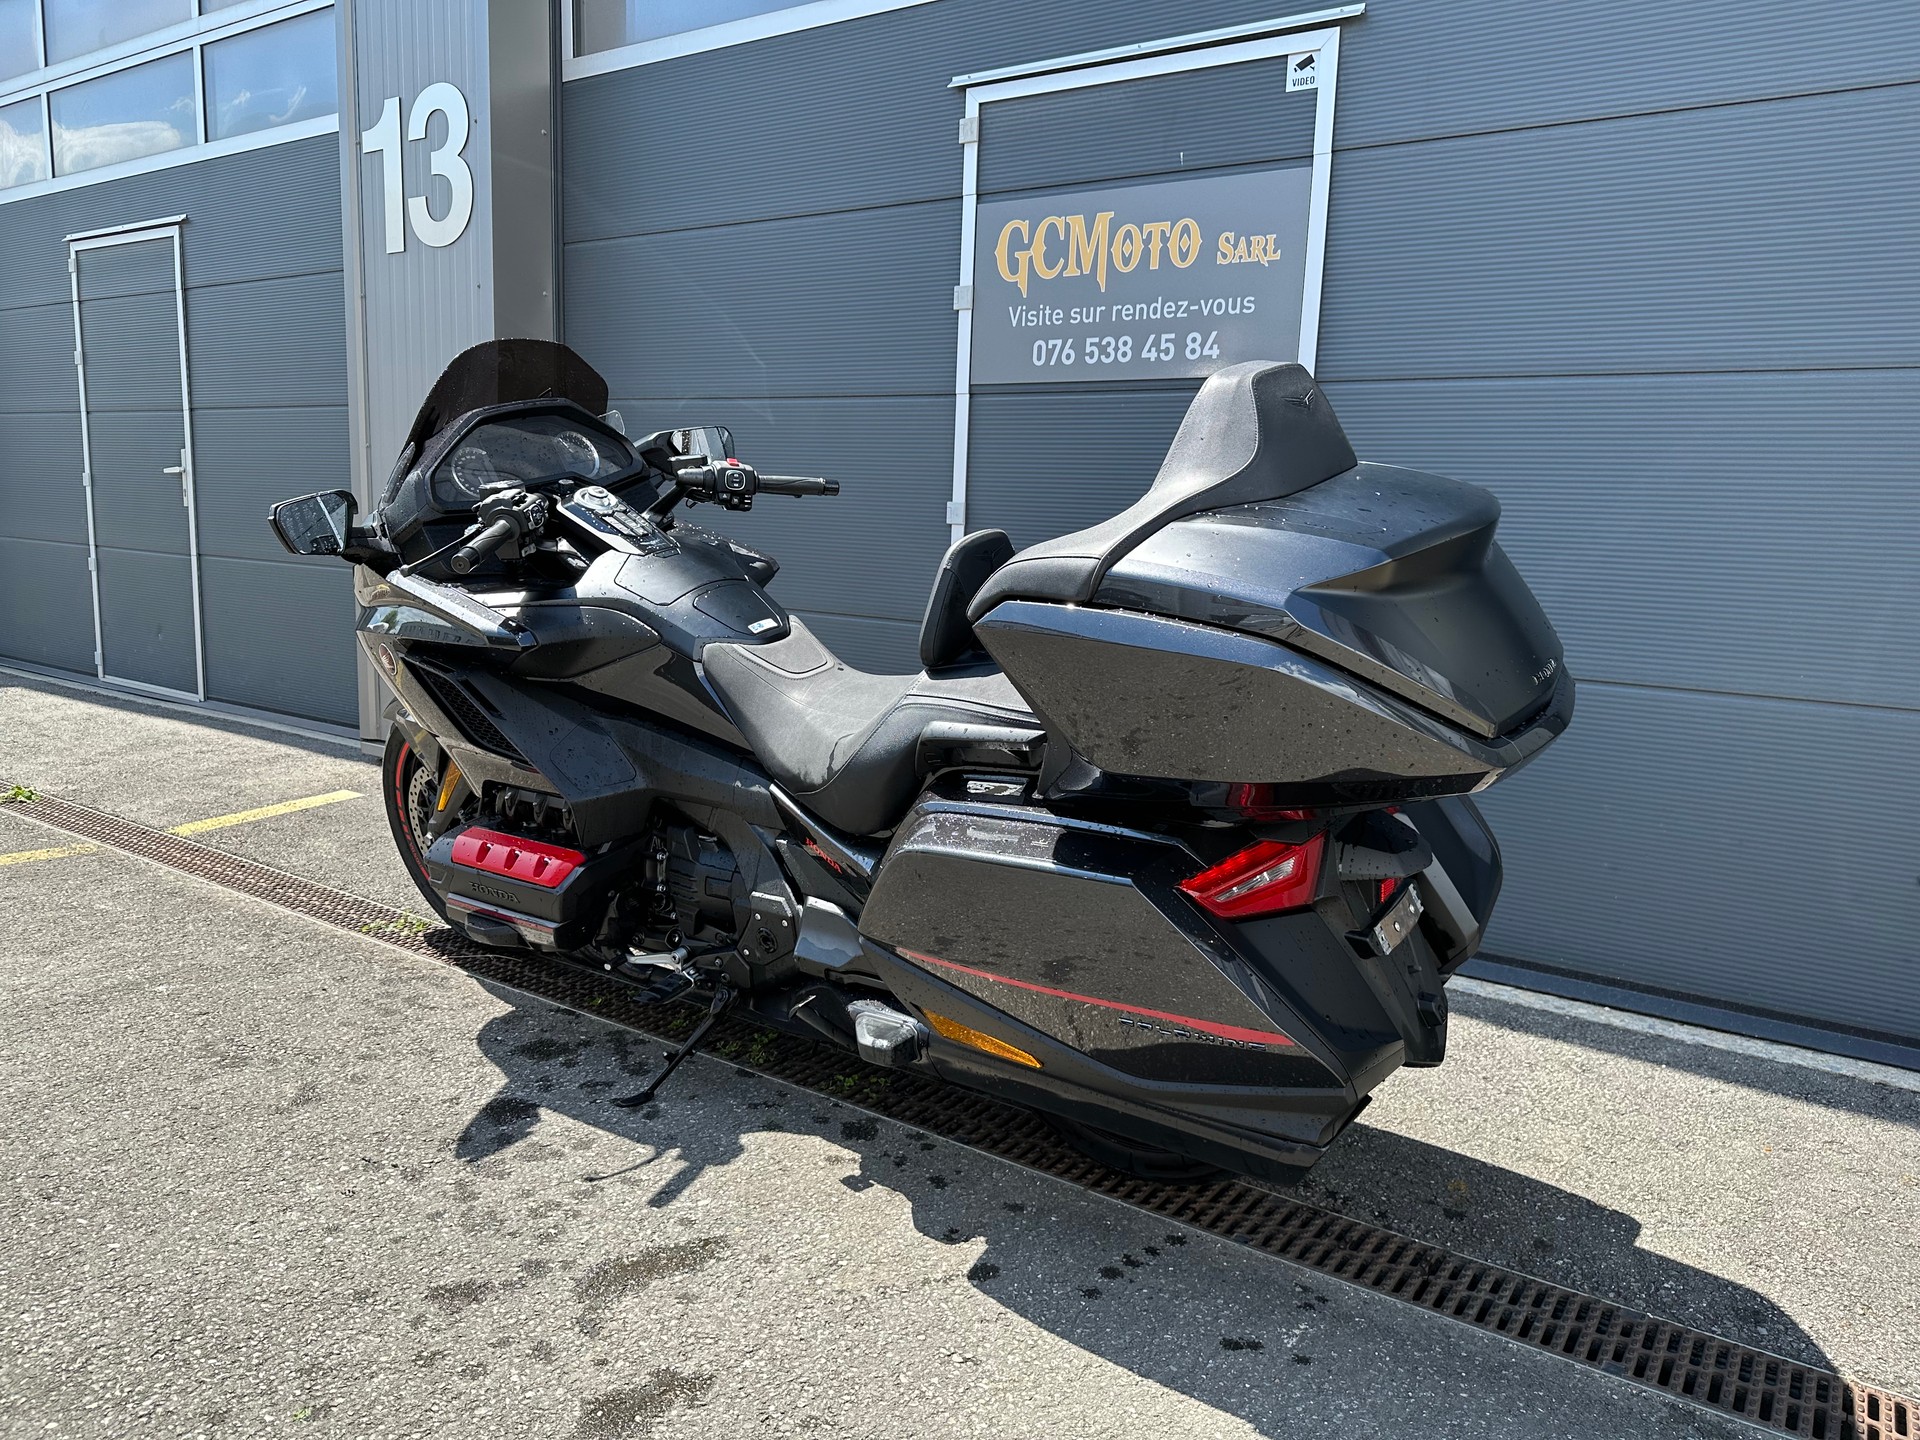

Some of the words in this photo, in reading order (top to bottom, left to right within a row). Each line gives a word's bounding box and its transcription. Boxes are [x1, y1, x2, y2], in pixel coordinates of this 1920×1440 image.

[1292, 75, 1315, 87] VIDEO
[362, 82, 473, 254] 13
[1008, 304, 1064, 327] Visite
[1069, 304, 1105, 324] sur
[1111, 296, 1256, 322] rendez-vous
[1032, 338, 1076, 366] 076
[1084, 335, 1133, 365] 538
[1141, 333, 1176, 362] 45
[1184, 330, 1220, 361] 84
[805, 837, 843, 875] HONDA
[468, 880, 521, 904] HONDA
